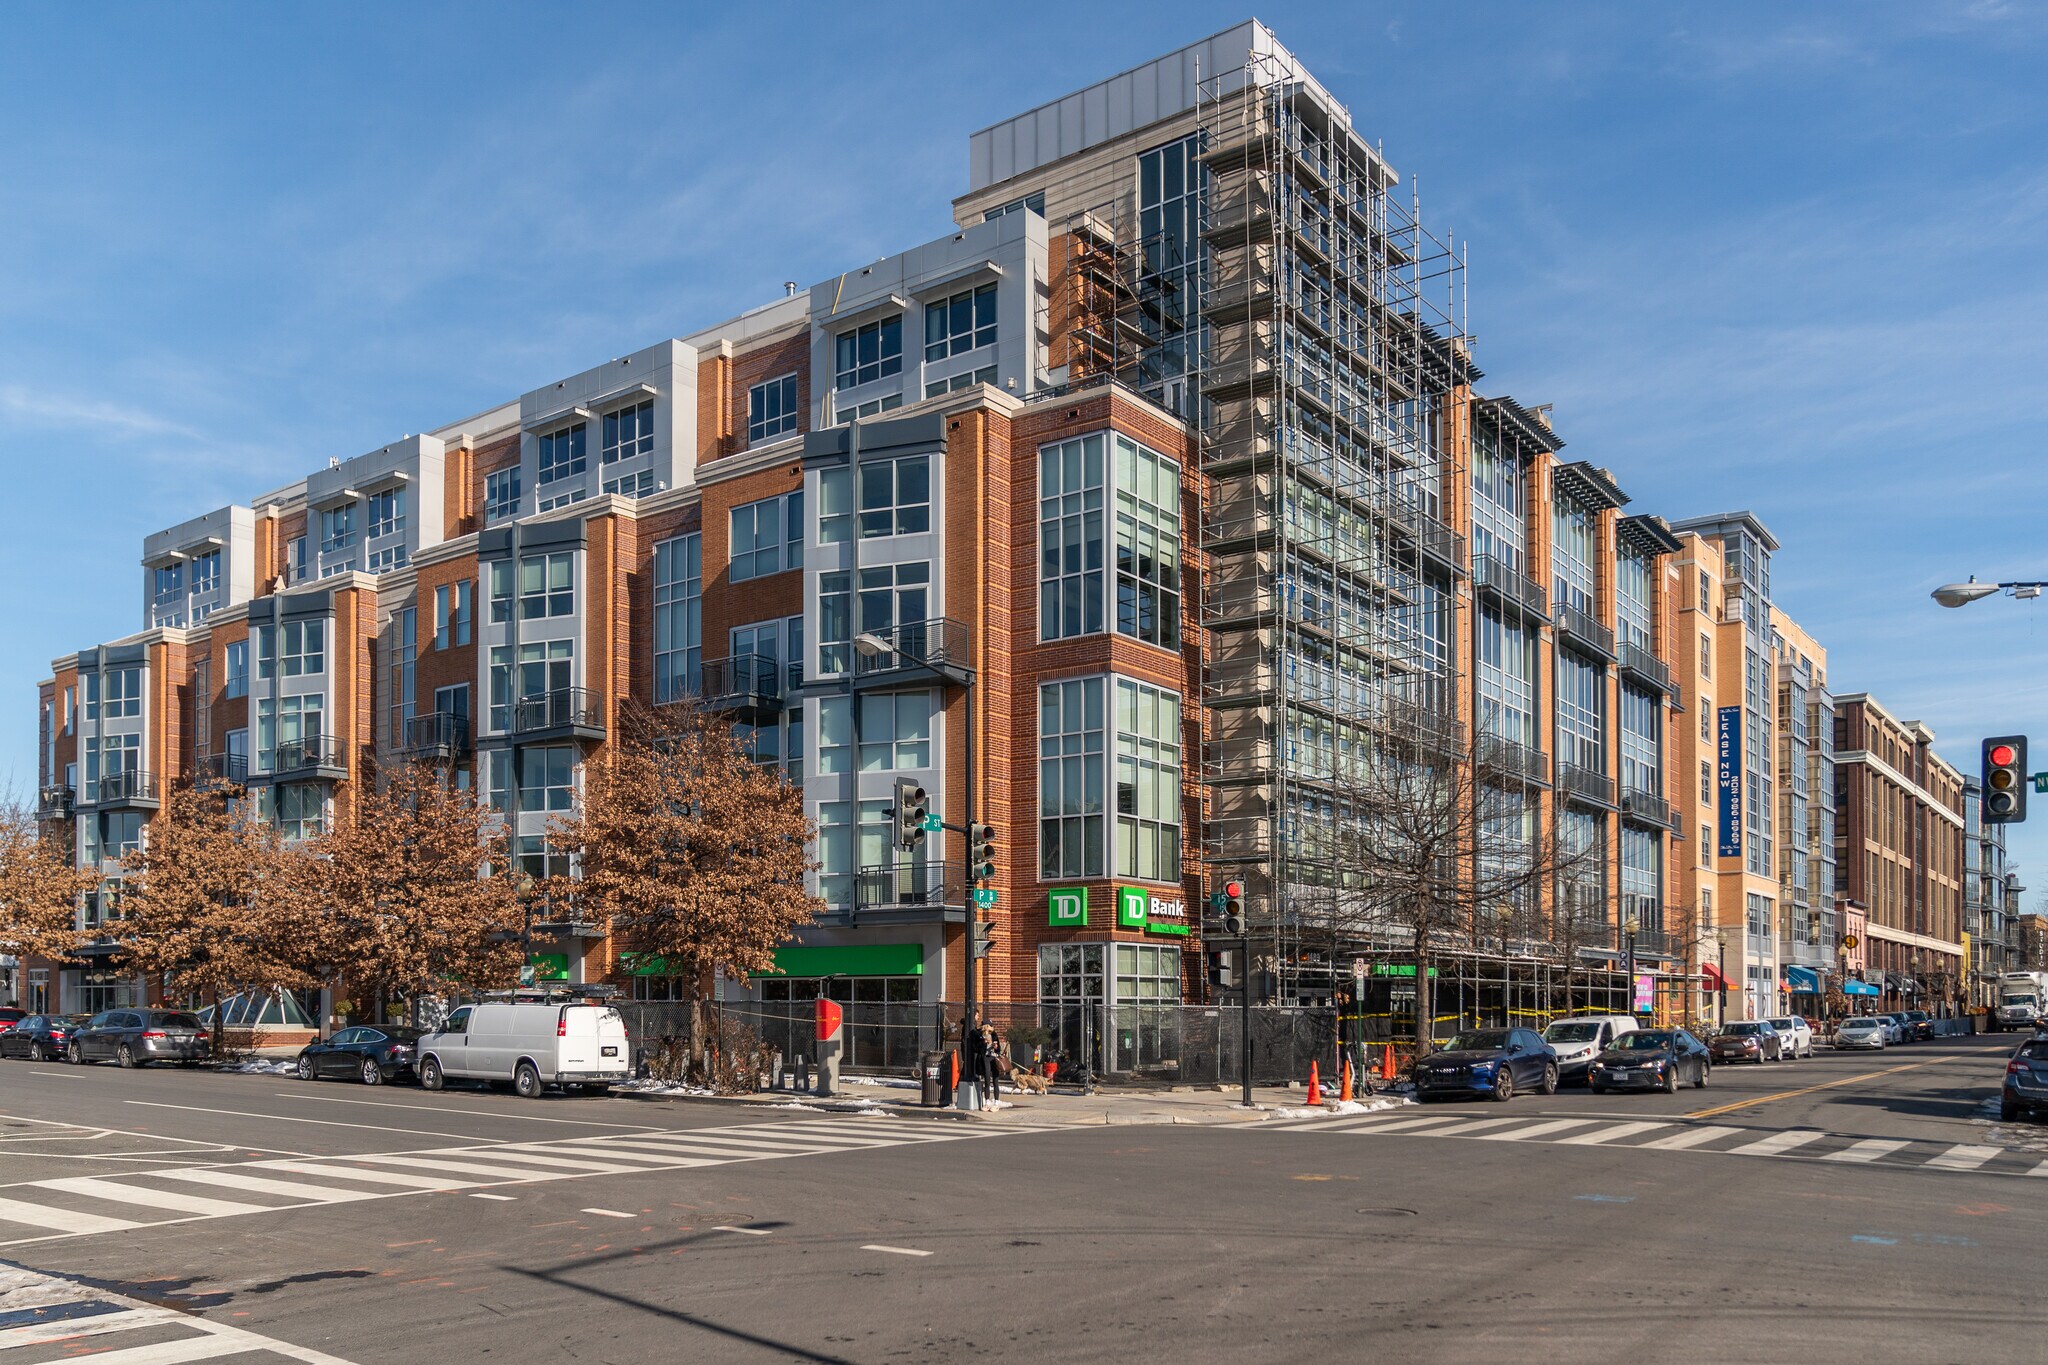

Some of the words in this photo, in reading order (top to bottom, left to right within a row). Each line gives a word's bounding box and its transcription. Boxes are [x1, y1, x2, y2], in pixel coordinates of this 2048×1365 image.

[1721, 714, 1729, 757] LEASE
[1720, 762, 1730, 787] NOW
[923, 815, 930, 828] P
[934, 818, 940, 828] ST
[979, 890, 984, 900] P
[1217, 894, 1226, 905] 15
[978, 901, 992, 909] 1400
[1053, 895, 1081, 919] TD
[1126, 894, 1145, 919] TD
[1150, 897, 1184, 917] Bank
